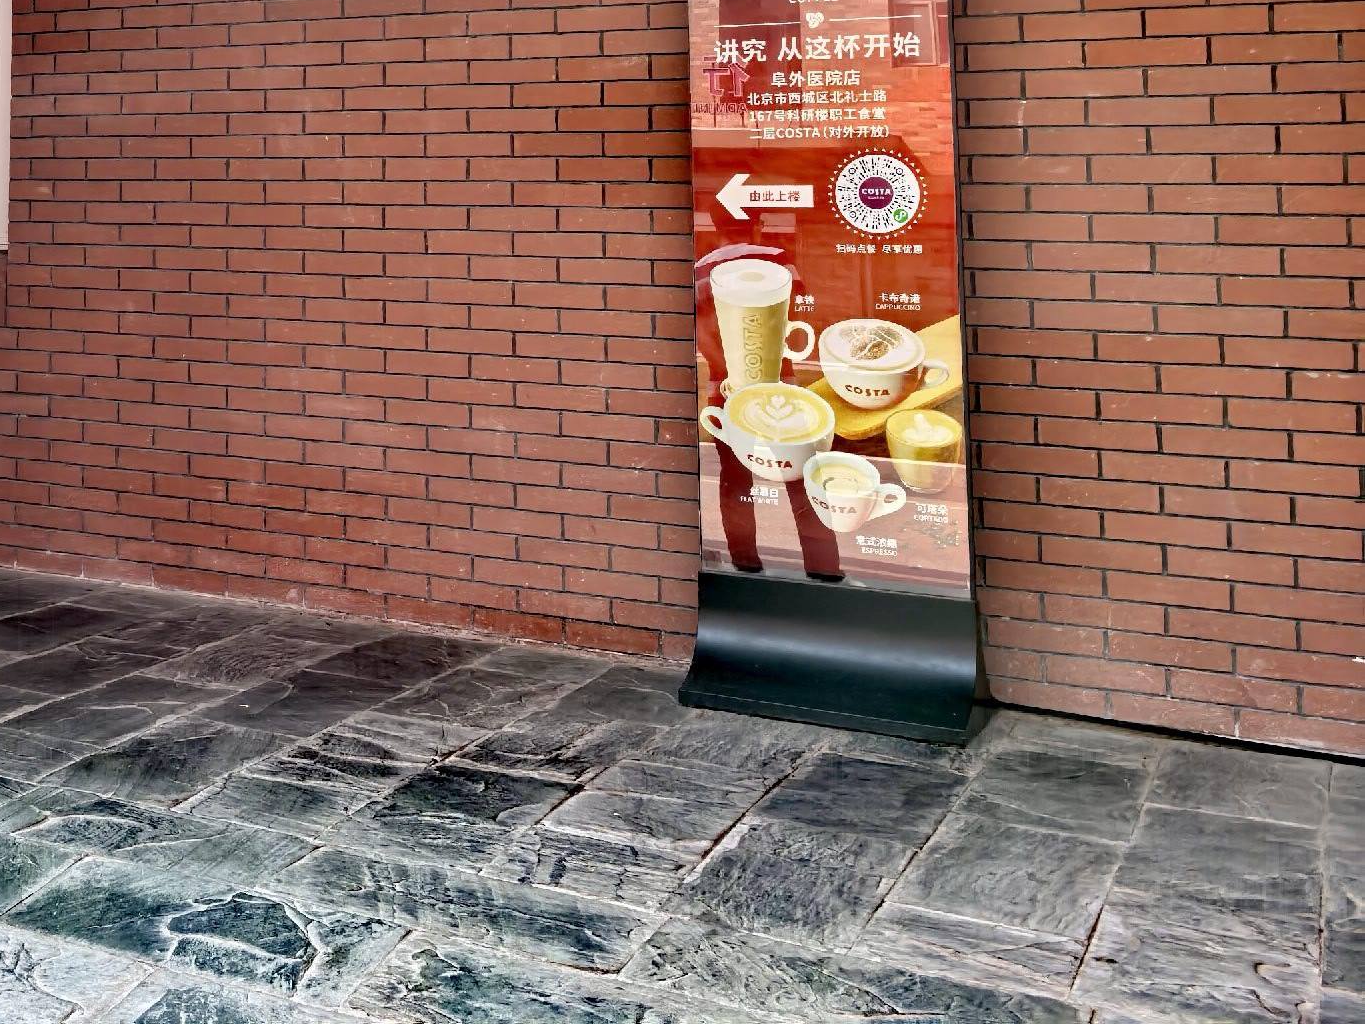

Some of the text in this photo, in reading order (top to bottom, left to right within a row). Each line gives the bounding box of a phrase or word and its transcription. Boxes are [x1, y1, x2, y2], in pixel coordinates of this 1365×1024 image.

[713, 31, 922, 64] 讲究 从这杯开始
[770, 69, 861, 88] 阜外医院店
[747, 89, 888, 106] 北京市西城区北礼士路
[748, 106, 887, 123] 167号科研楼职工食堂
[749, 189, 801, 203] 由此上楼
[861, 187, 892, 196] COSTA
[835, 243, 923, 254] 扫码点餐 尽享优惠
[878, 292, 921, 304] 卡布奇诺
[745, 313, 763, 382] COSTA
[844, 383, 891, 398] COSTA
[746, 453, 793, 469] COSTA
[811, 495, 858, 515] COSTA
